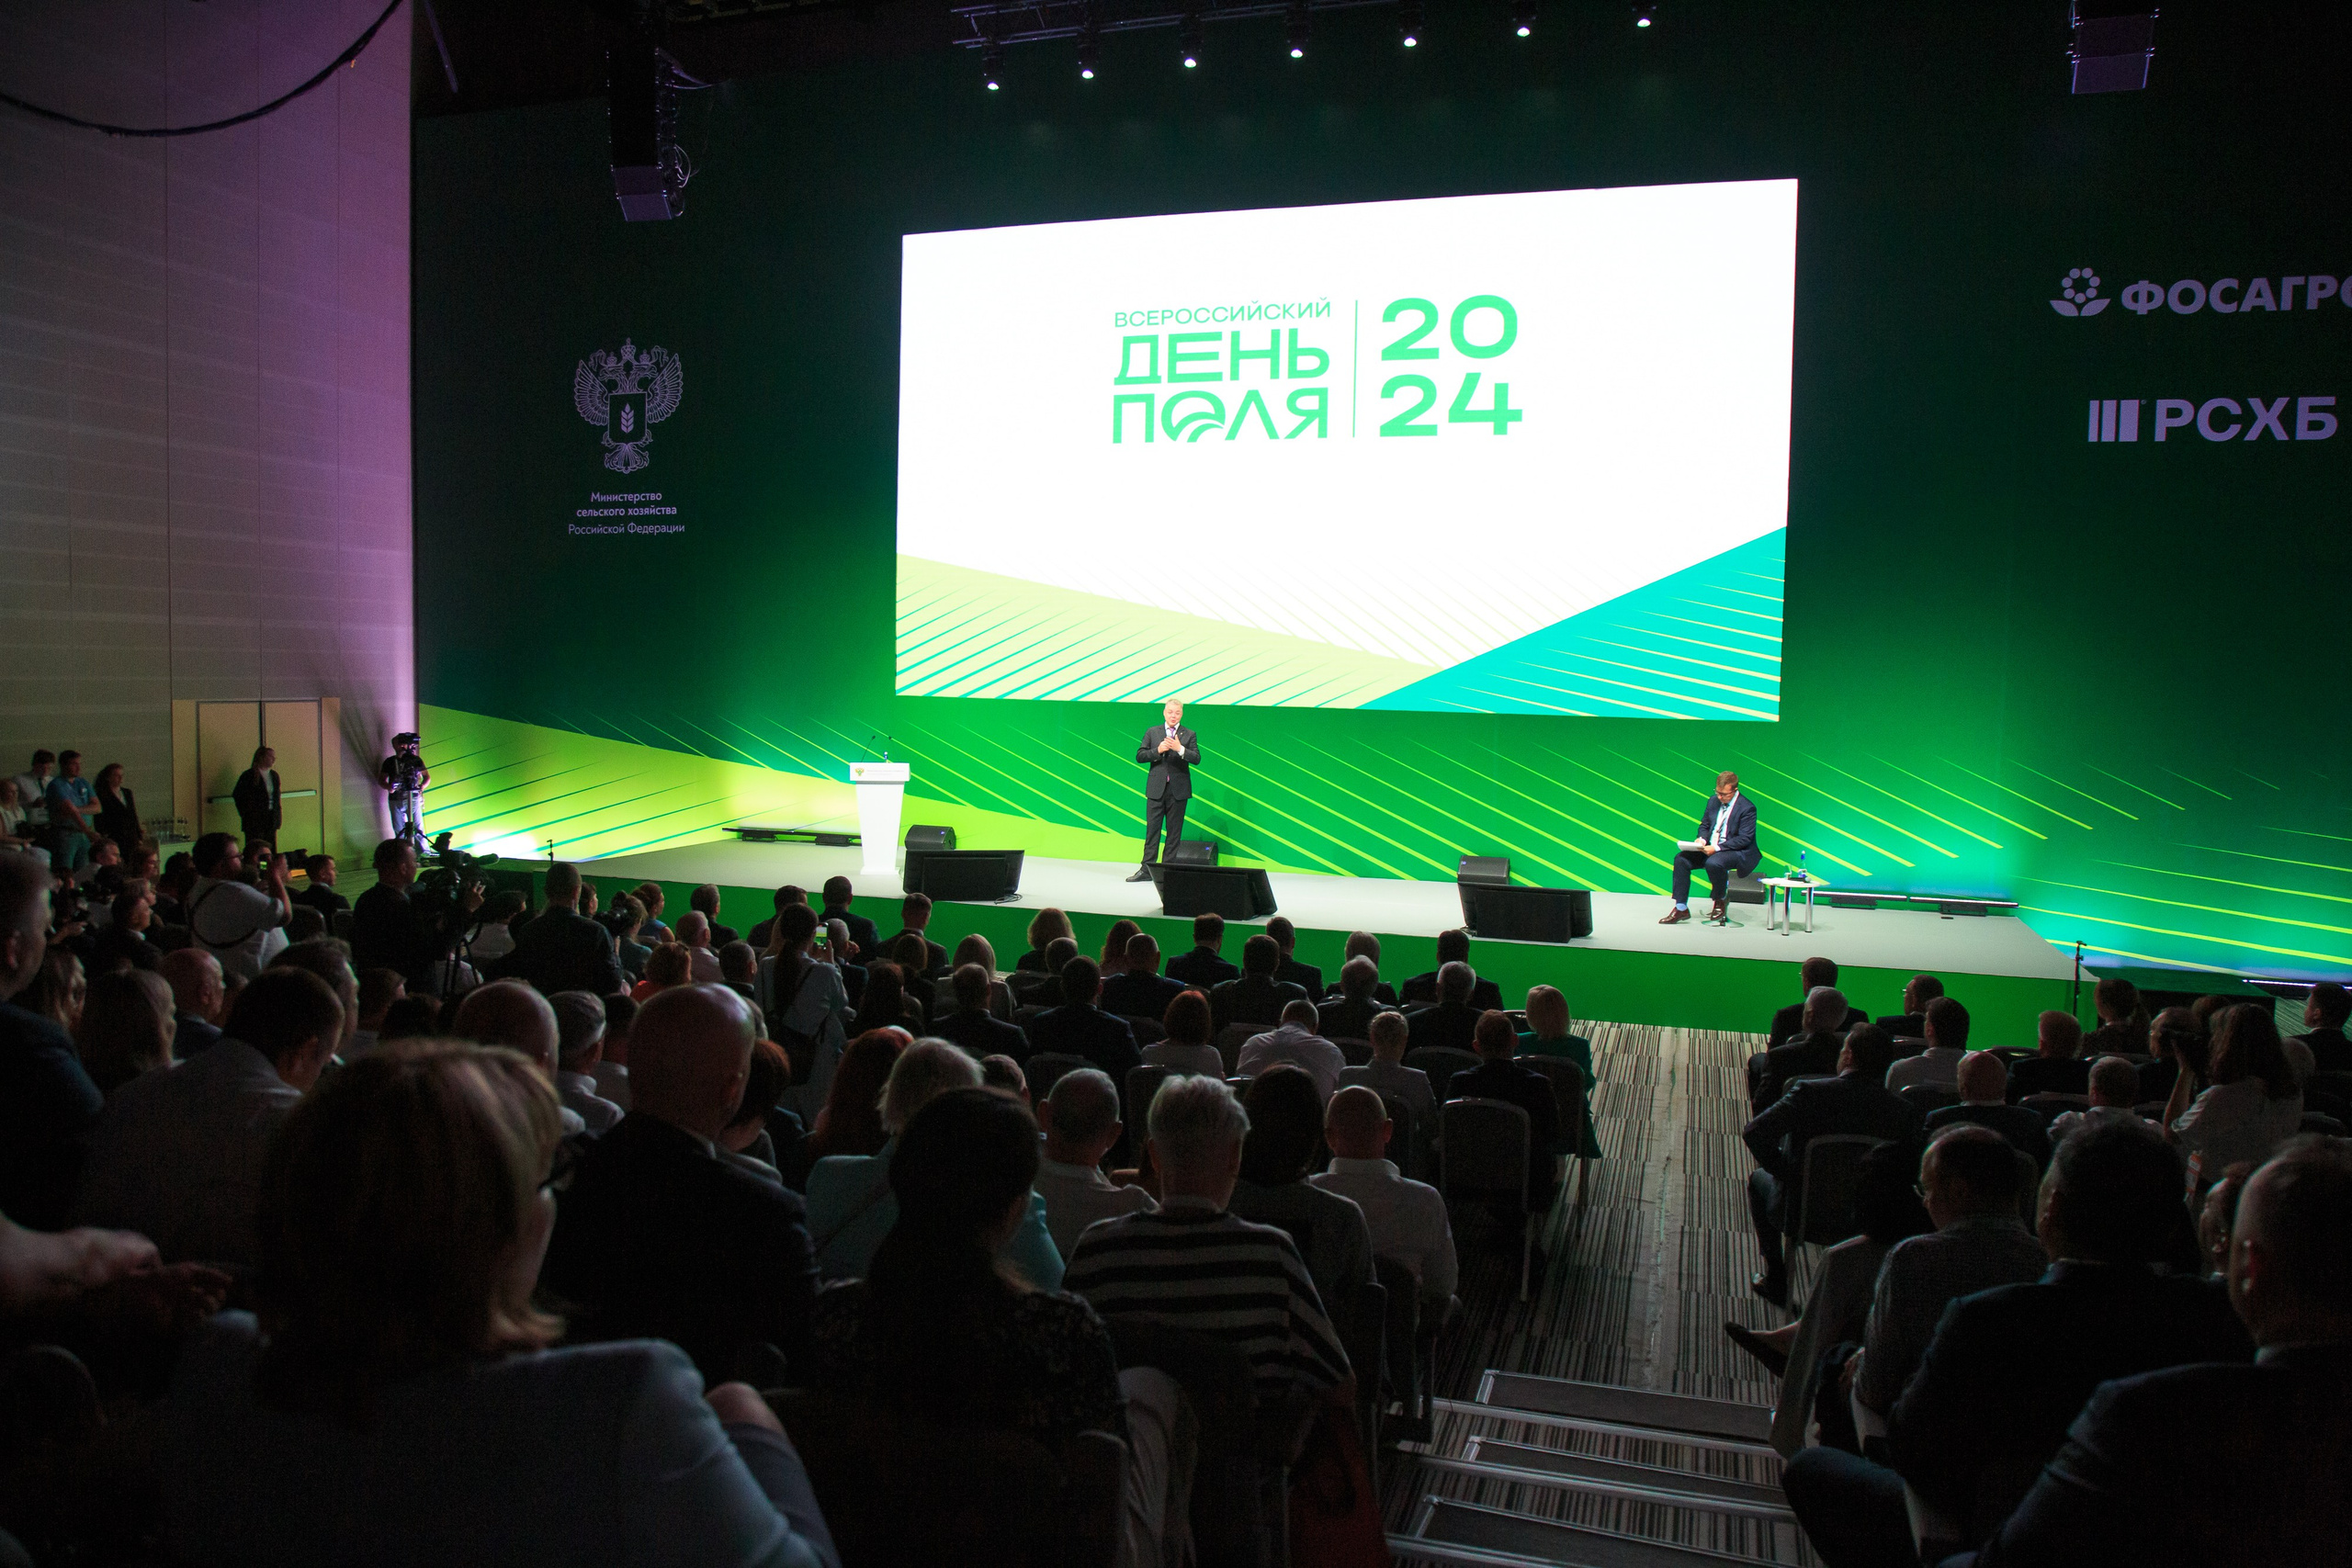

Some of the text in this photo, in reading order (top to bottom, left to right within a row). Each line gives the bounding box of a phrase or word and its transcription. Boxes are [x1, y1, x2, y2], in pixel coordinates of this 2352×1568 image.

[1114, 297, 1331, 328] ВСЕРОССИЙСКИЙ
[1381, 294, 1519, 362] 20
[1113, 327, 1331, 387] ДЕНЬ
[1112, 386, 1330, 445] ПОЛЯ
[1379, 371, 1524, 438] 24
[2154, 396, 2339, 442] РСХБ
[576, 504, 677, 518] сельского хозяйства
[591, 491, 662, 503] Министерство
[568, 522, 685, 536] Российской Федерации
